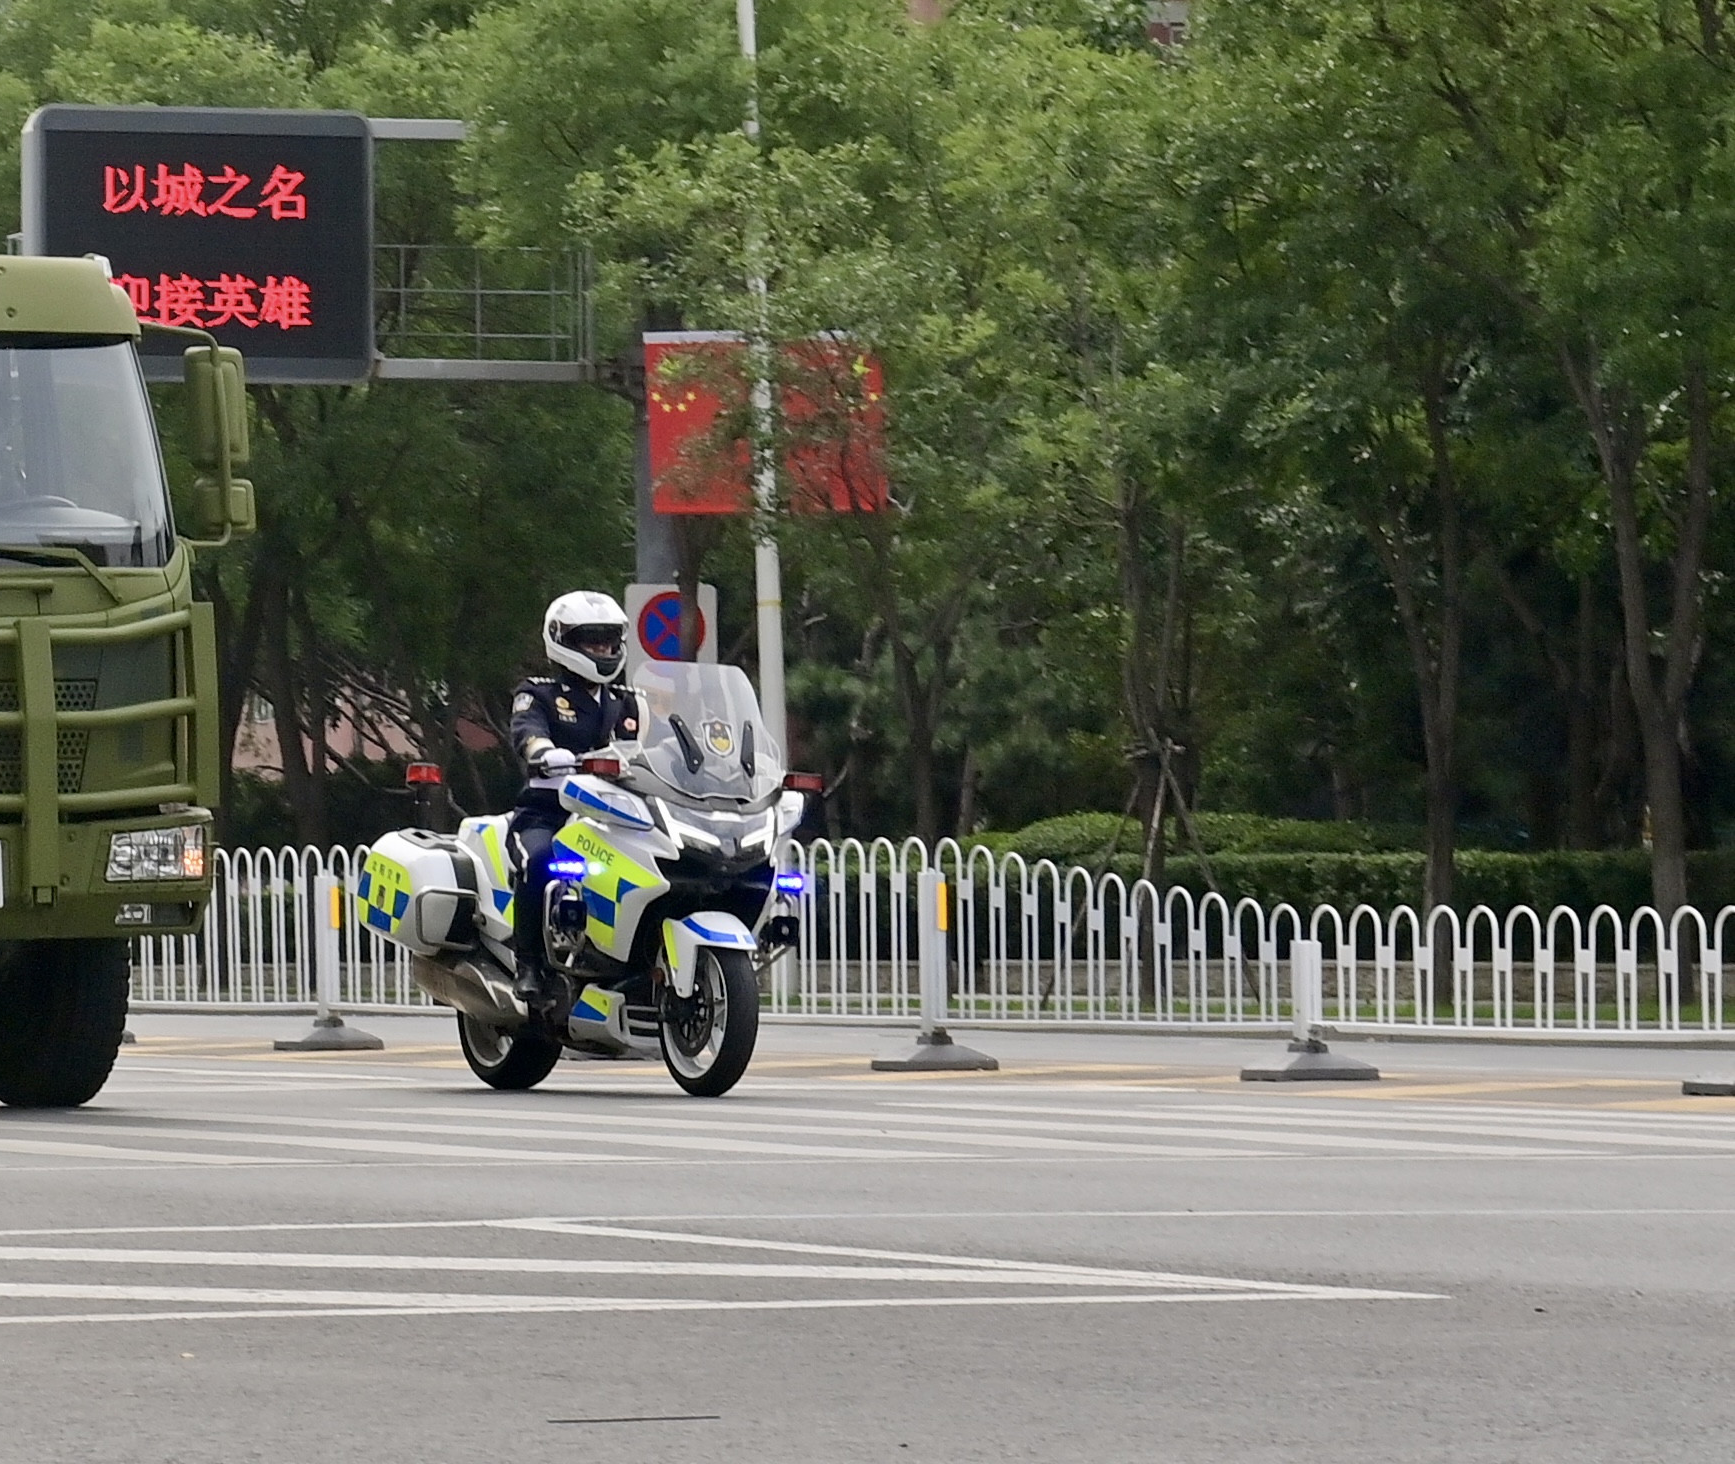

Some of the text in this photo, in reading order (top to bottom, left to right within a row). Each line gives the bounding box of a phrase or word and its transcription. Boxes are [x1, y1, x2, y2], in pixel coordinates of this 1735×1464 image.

[102, 162, 307, 221] 以城之名
[576, 833, 615, 867] POLICE
